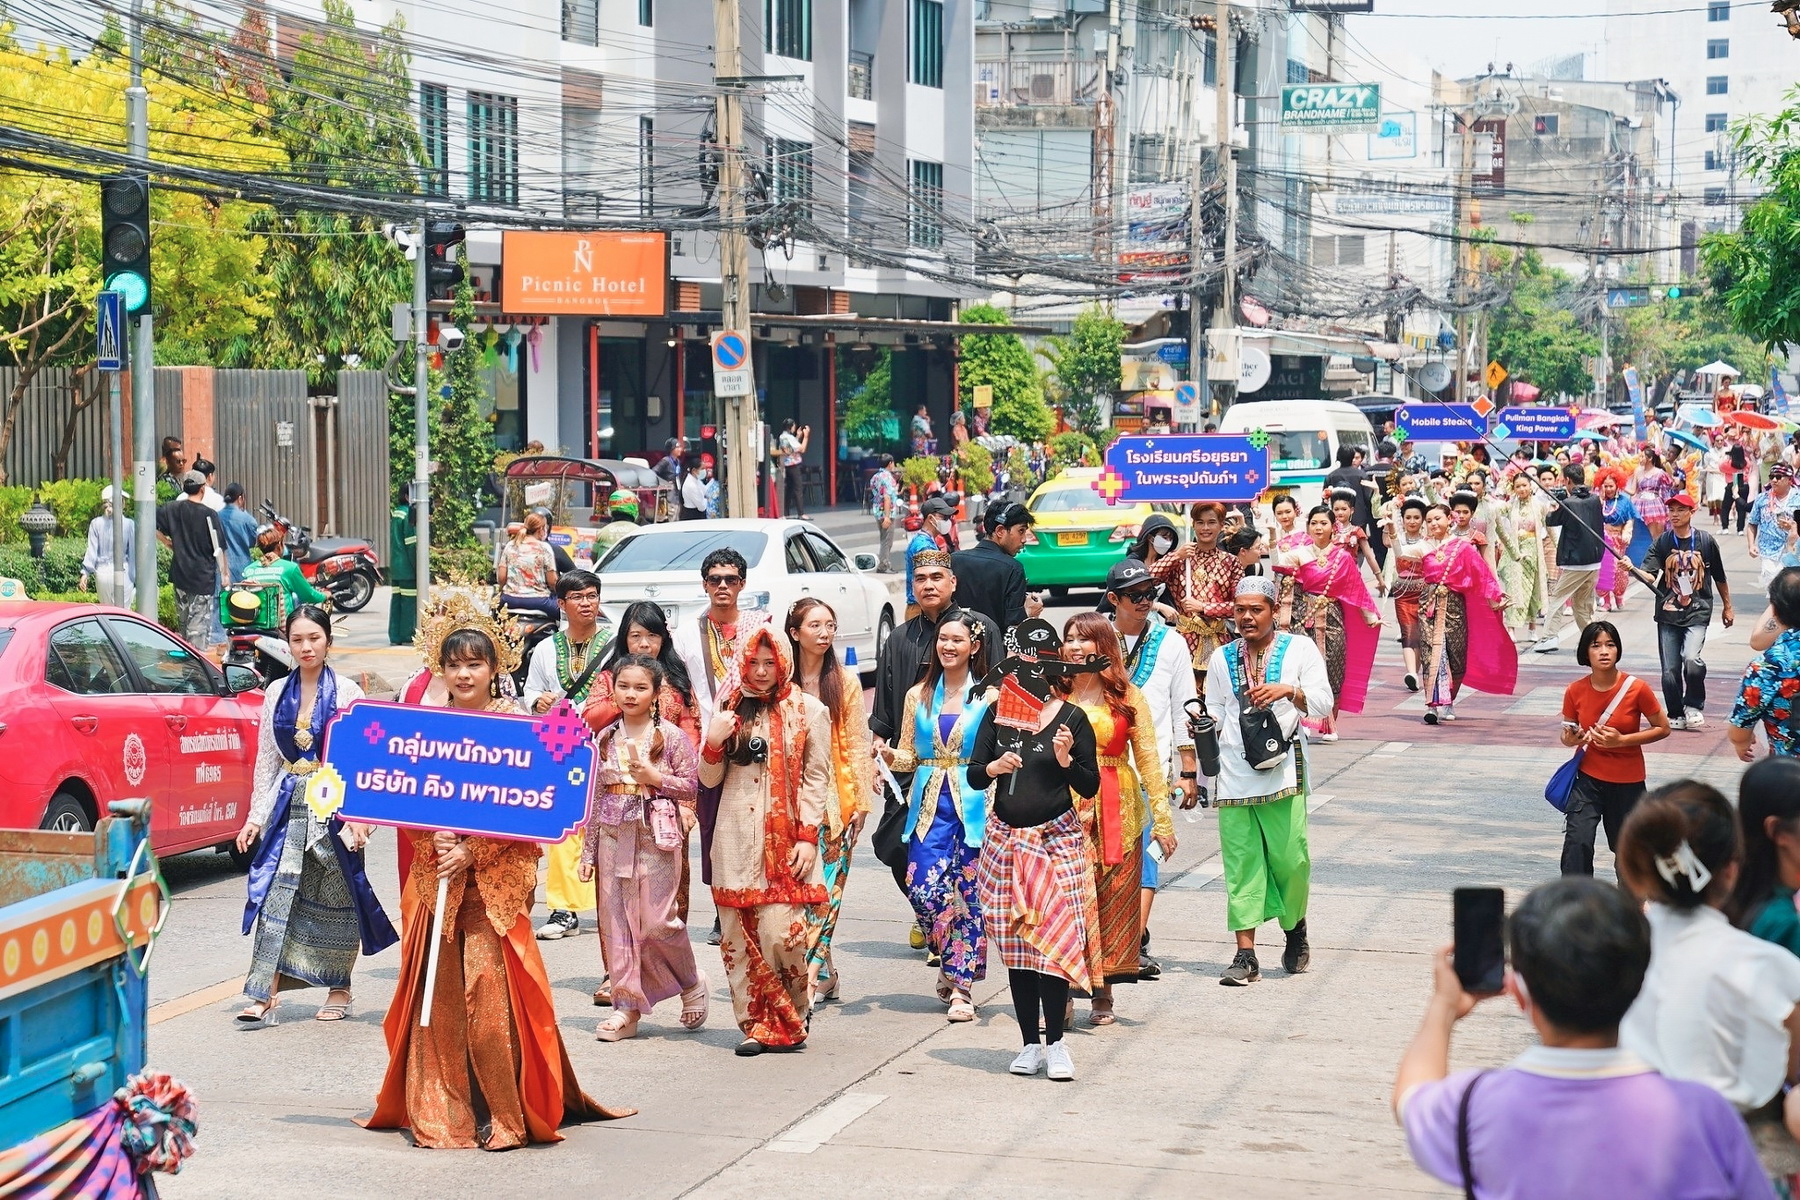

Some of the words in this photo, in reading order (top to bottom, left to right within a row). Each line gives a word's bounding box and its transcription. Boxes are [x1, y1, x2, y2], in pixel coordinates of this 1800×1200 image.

[1290, 87, 1373, 110] CRAZY
[1284, 109, 1346, 120] BRANDNAME
[521, 276, 582, 292] Picnic
[592, 276, 645, 293] Hotel
[1411, 417, 1441, 426] Mobile
[1505, 414, 1535, 422] Pullman
[1536, 414, 1570, 424] Bangkok
[1515, 425, 1533, 434] King
[1534, 425, 1558, 433] Power
[1126, 449, 1248, 467] โรงเรียนศรีอยุธยา
[1135, 470, 1238, 488] ในพระอุปถัมภ์ฯ
[388, 732, 532, 768] กลุ่มพนักงาน
[355, 768, 417, 795] บริษัท
[423, 774, 455, 798] คิง
[460, 783, 556, 810] เพาเวอร์
